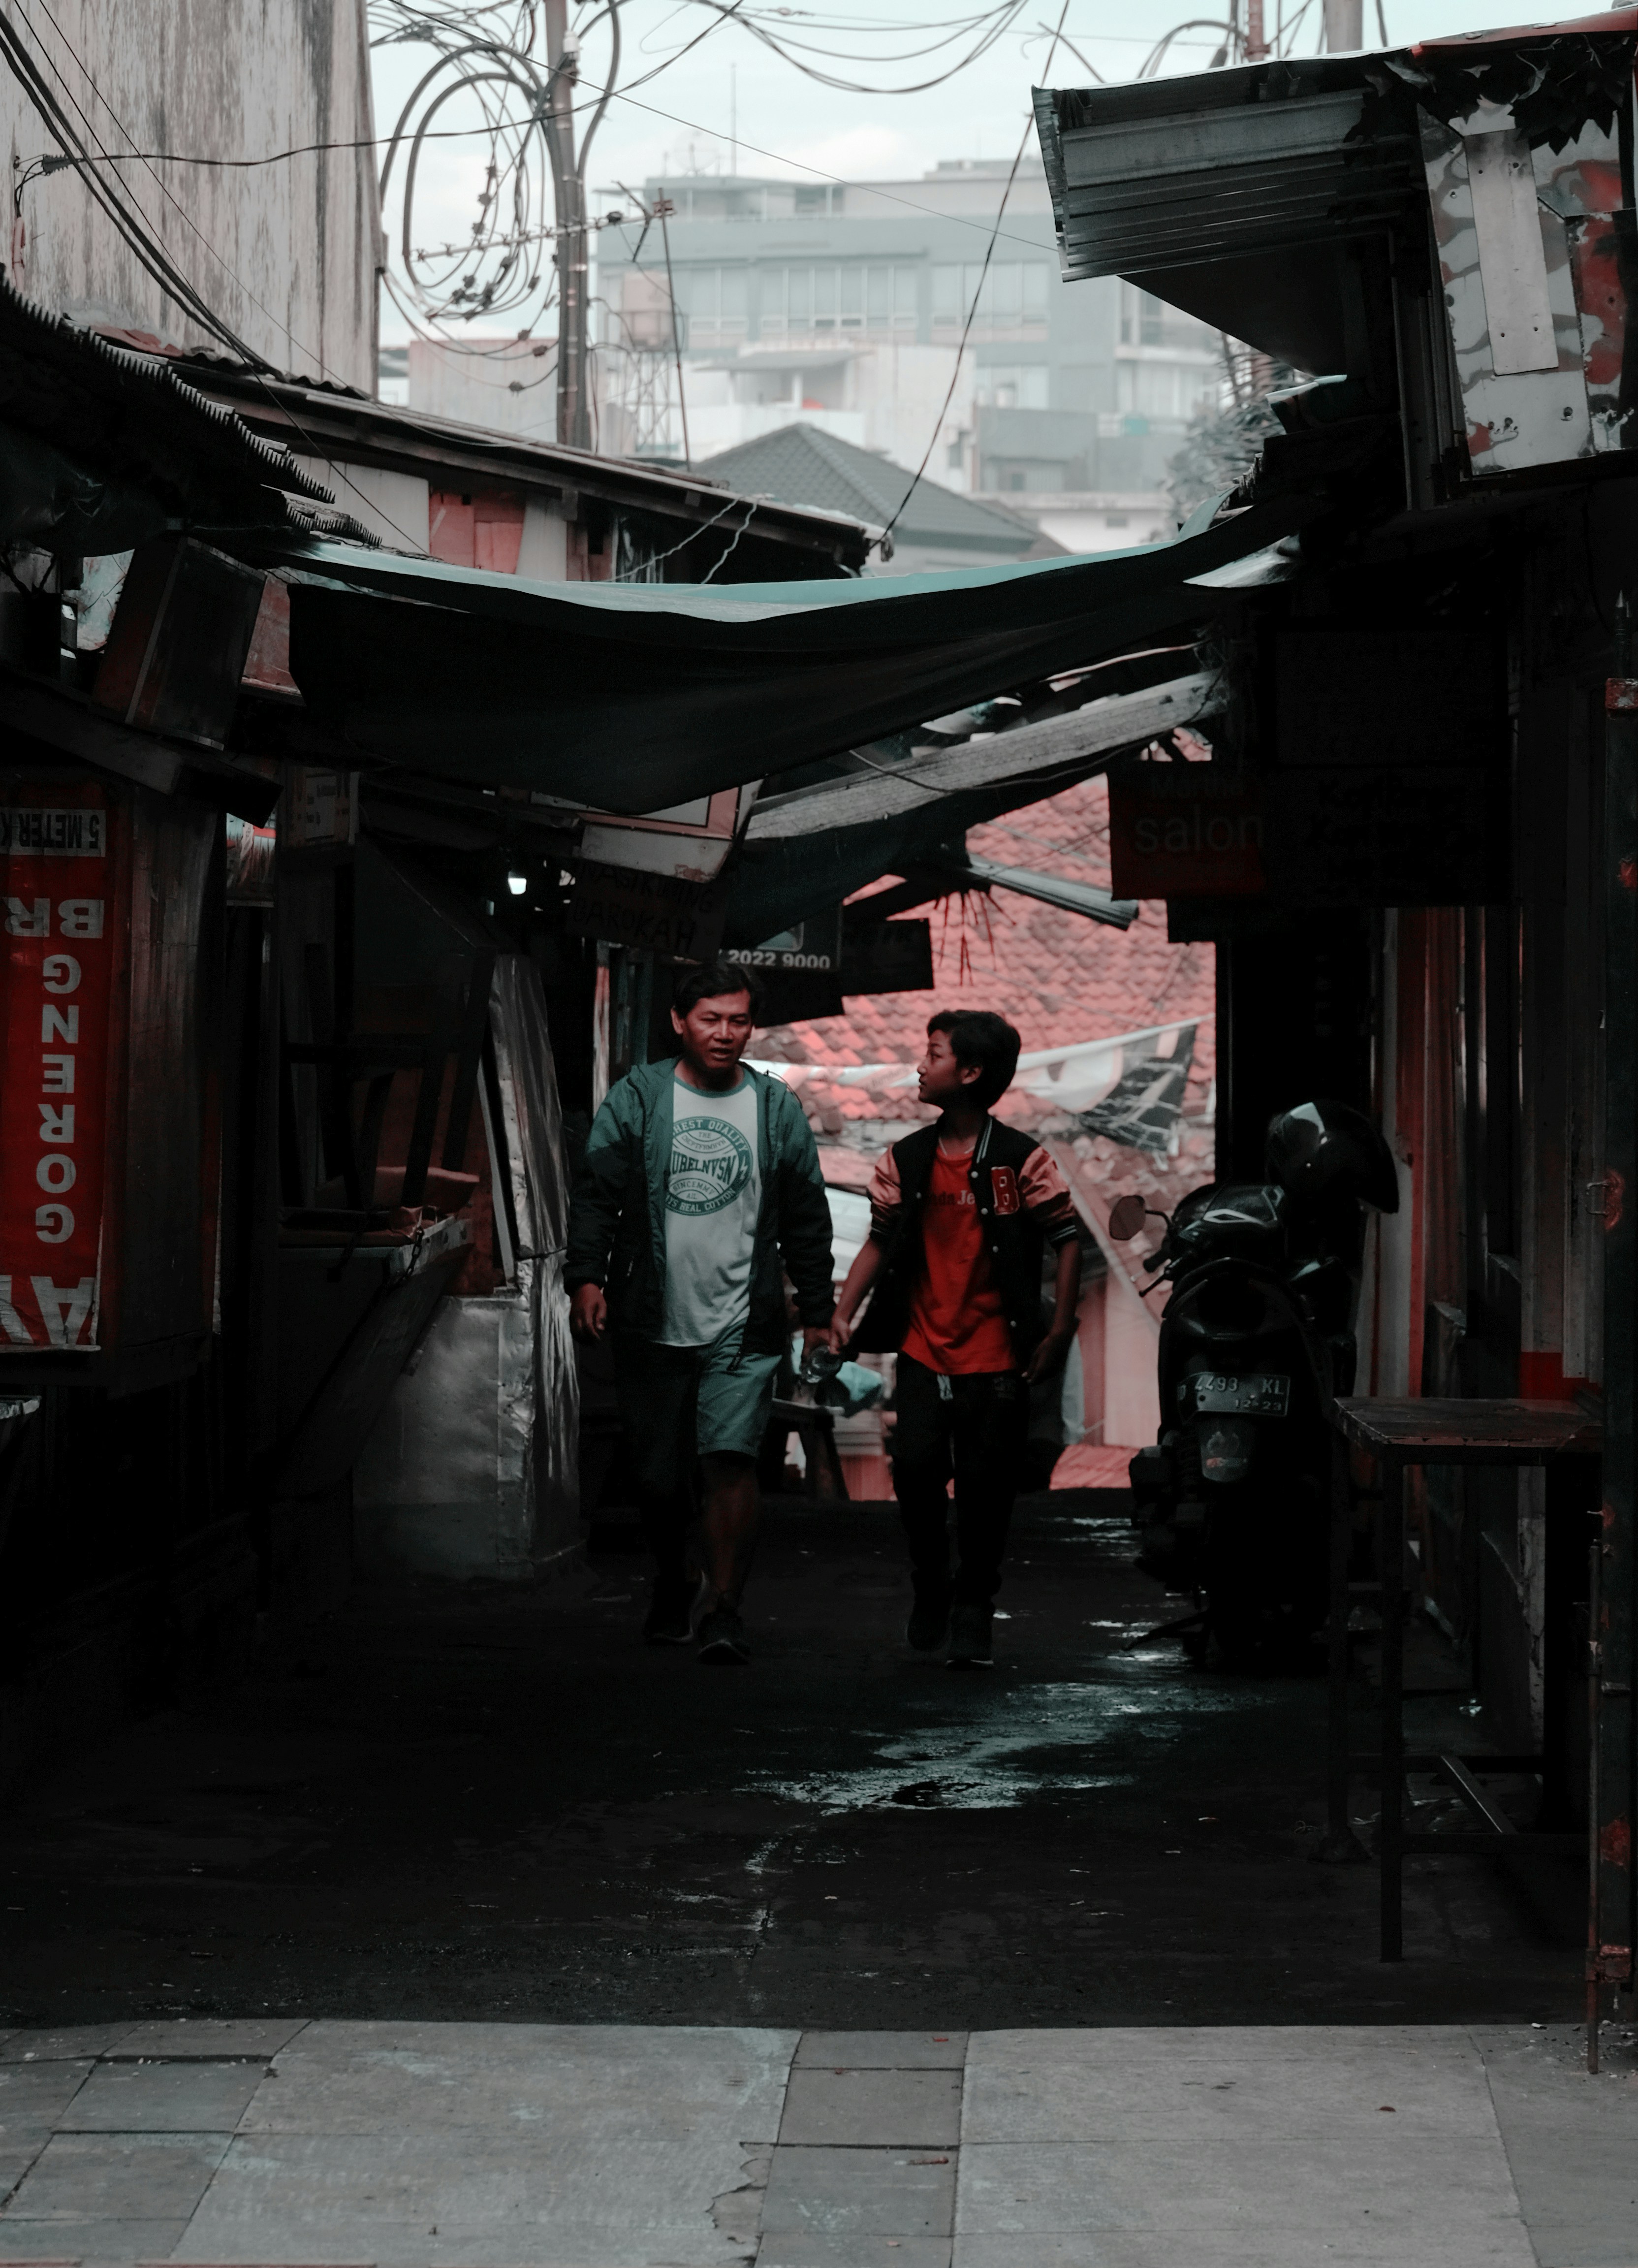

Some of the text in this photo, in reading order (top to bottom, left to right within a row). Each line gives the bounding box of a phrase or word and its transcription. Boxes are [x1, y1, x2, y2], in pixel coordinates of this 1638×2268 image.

[19, 813, 82, 848] METER
[89, 815, 99, 848] 5
[1135, 803, 1264, 854] salon
[728, 949, 831, 969] 2022 9000
[35, 954, 82, 1244] GORENG
[673, 1119, 703, 1136] HEST
[708, 1120, 749, 1151] QUALITY
[679, 1202, 702, 1212] REAL
[704, 1187, 737, 1211] COTTON
[991, 1166, 1020, 1216] B
[1261, 1378, 1285, 1395] KL
